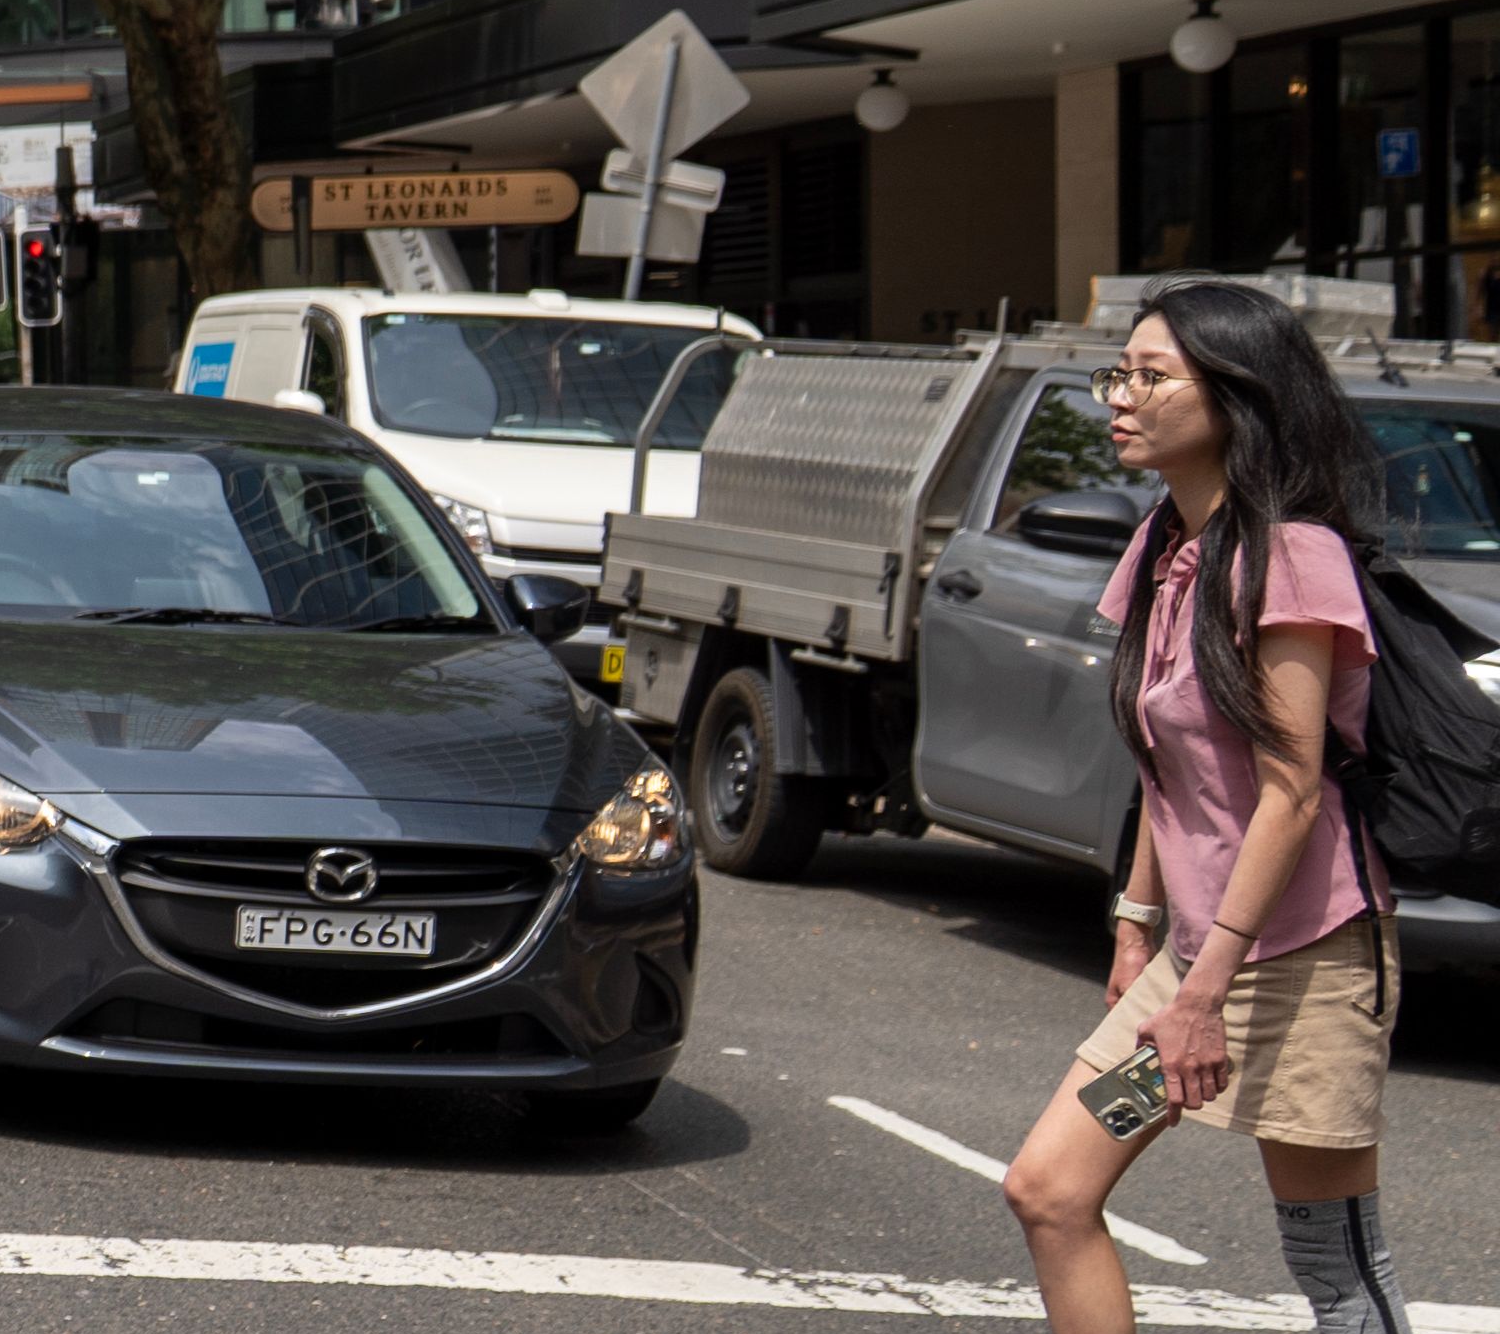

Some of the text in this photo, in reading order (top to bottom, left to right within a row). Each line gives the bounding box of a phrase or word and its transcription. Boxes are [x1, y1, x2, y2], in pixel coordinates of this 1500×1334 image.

[324, 177, 509, 202] ST LEONARDS
[365, 201, 469, 221] TAVERN
